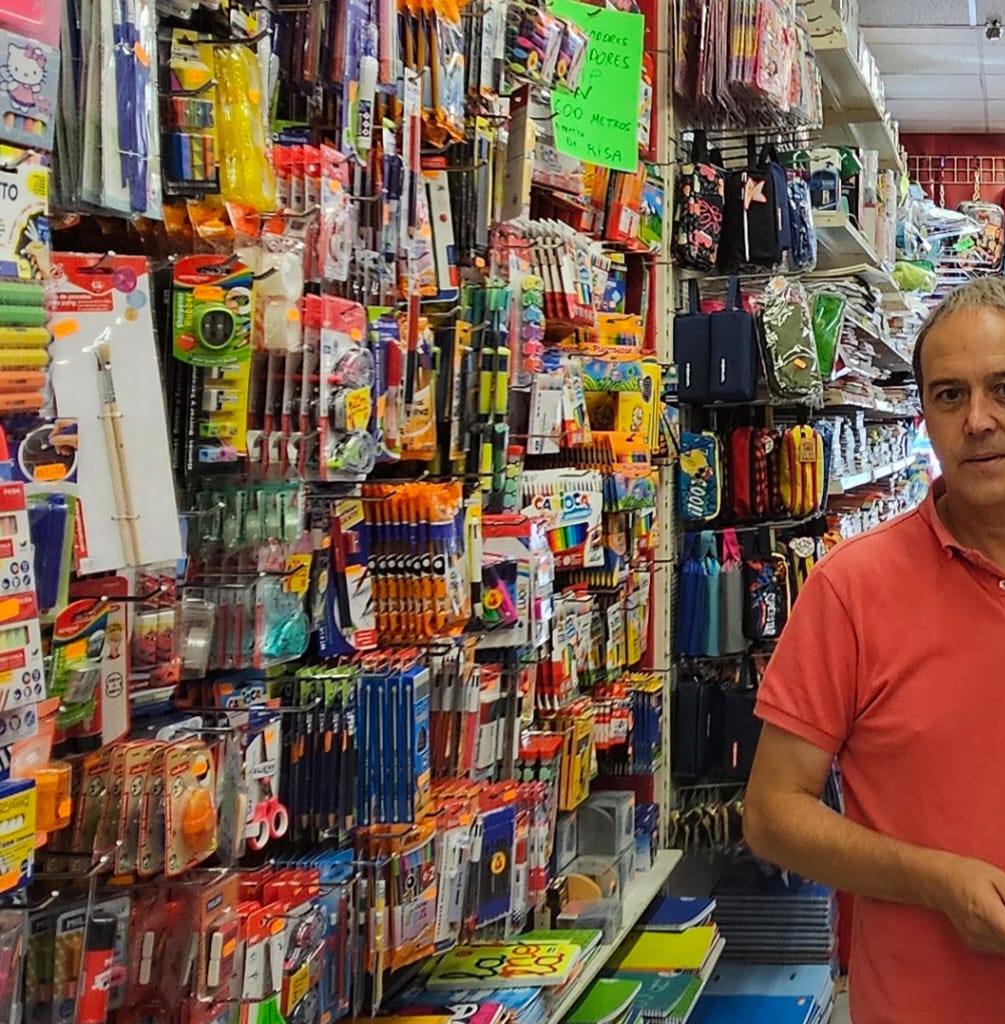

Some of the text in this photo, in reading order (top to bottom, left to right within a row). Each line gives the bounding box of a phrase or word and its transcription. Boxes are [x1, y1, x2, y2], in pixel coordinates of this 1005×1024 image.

[585, 48, 630, 69] DORES
[590, 113, 631, 131] METROS
[587, 143, 622, 162] RISA
[0, 183, 18, 201] TO
